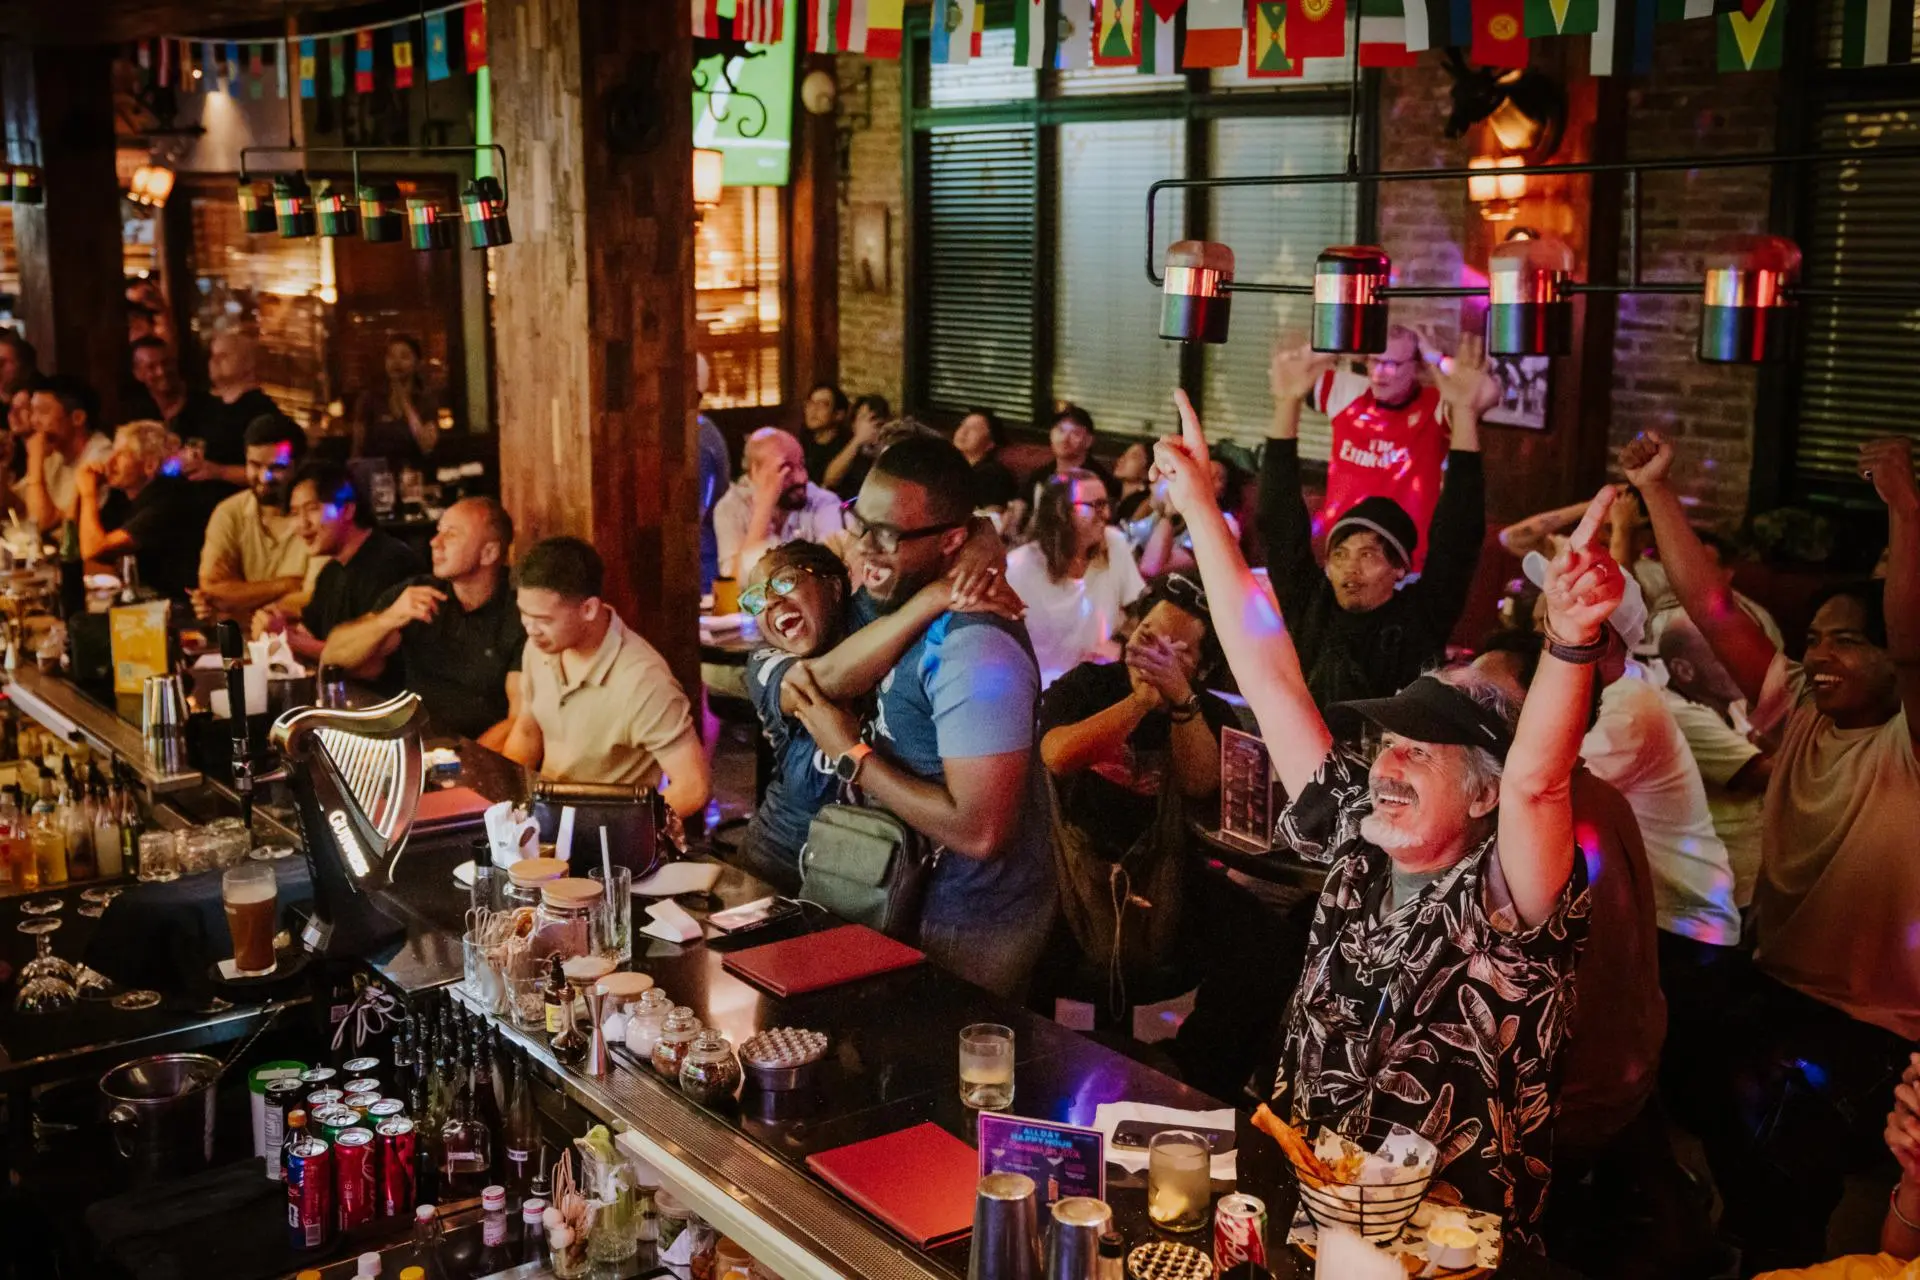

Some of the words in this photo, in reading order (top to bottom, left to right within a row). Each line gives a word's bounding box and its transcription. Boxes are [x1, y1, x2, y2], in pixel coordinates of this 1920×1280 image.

[1023, 1127, 1040, 1137] ALL
[1040, 1130, 1061, 1139] DAY
[1010, 1133, 1044, 1143] HAPPY
[1044, 1138, 1073, 1148] HOUR
